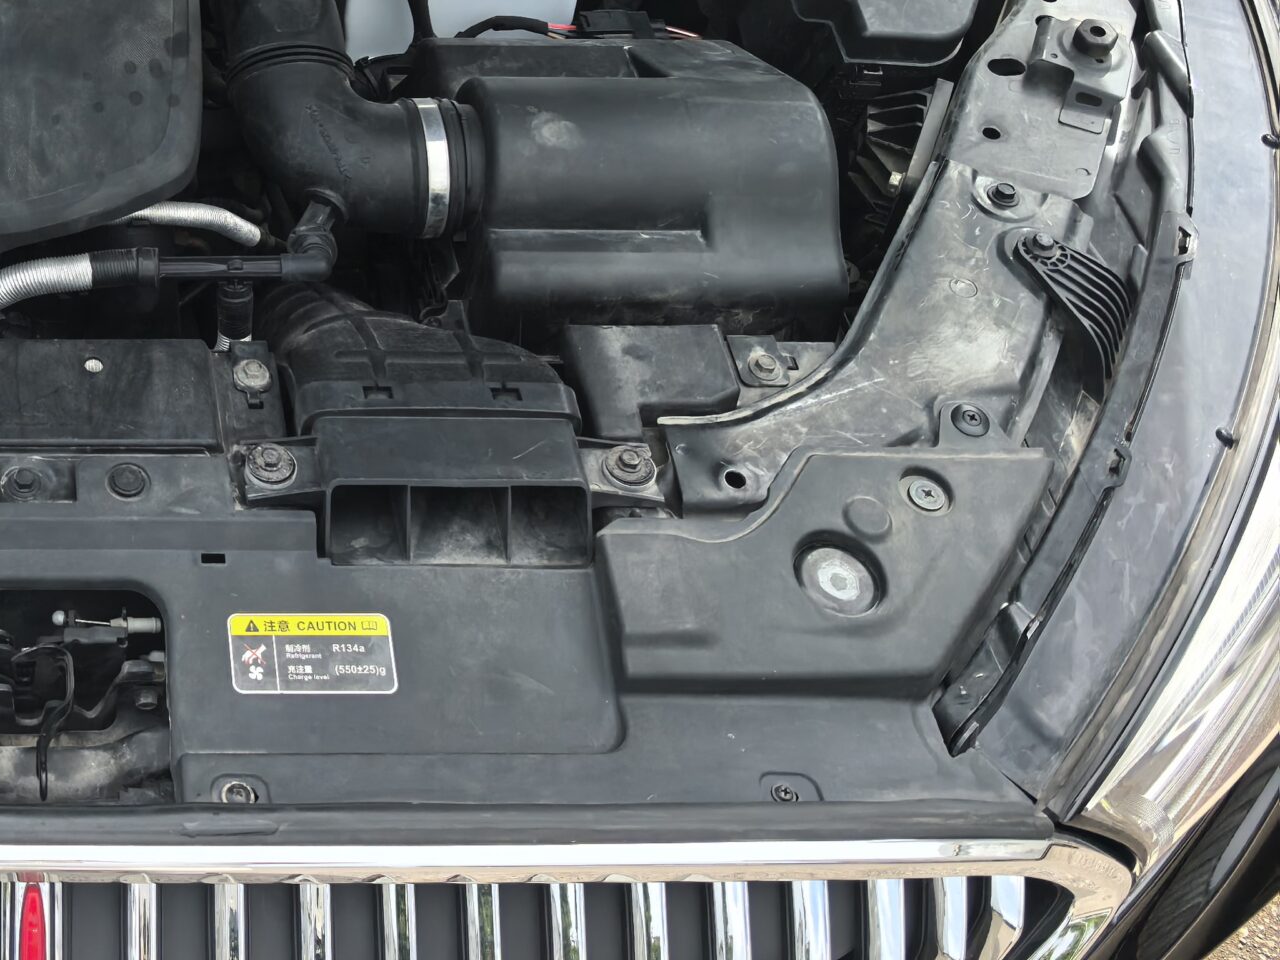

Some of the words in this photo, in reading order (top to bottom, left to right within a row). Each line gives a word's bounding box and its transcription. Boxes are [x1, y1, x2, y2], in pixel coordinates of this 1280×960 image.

[263, 620, 290, 632] 注意
[297, 621, 357, 631] CAUTION
[285, 644, 311, 653] 制冷剂
[332, 643, 366, 653] R134a
[288, 665, 313, 674] 充注量
[334, 665, 386, 676] (550±25)g
